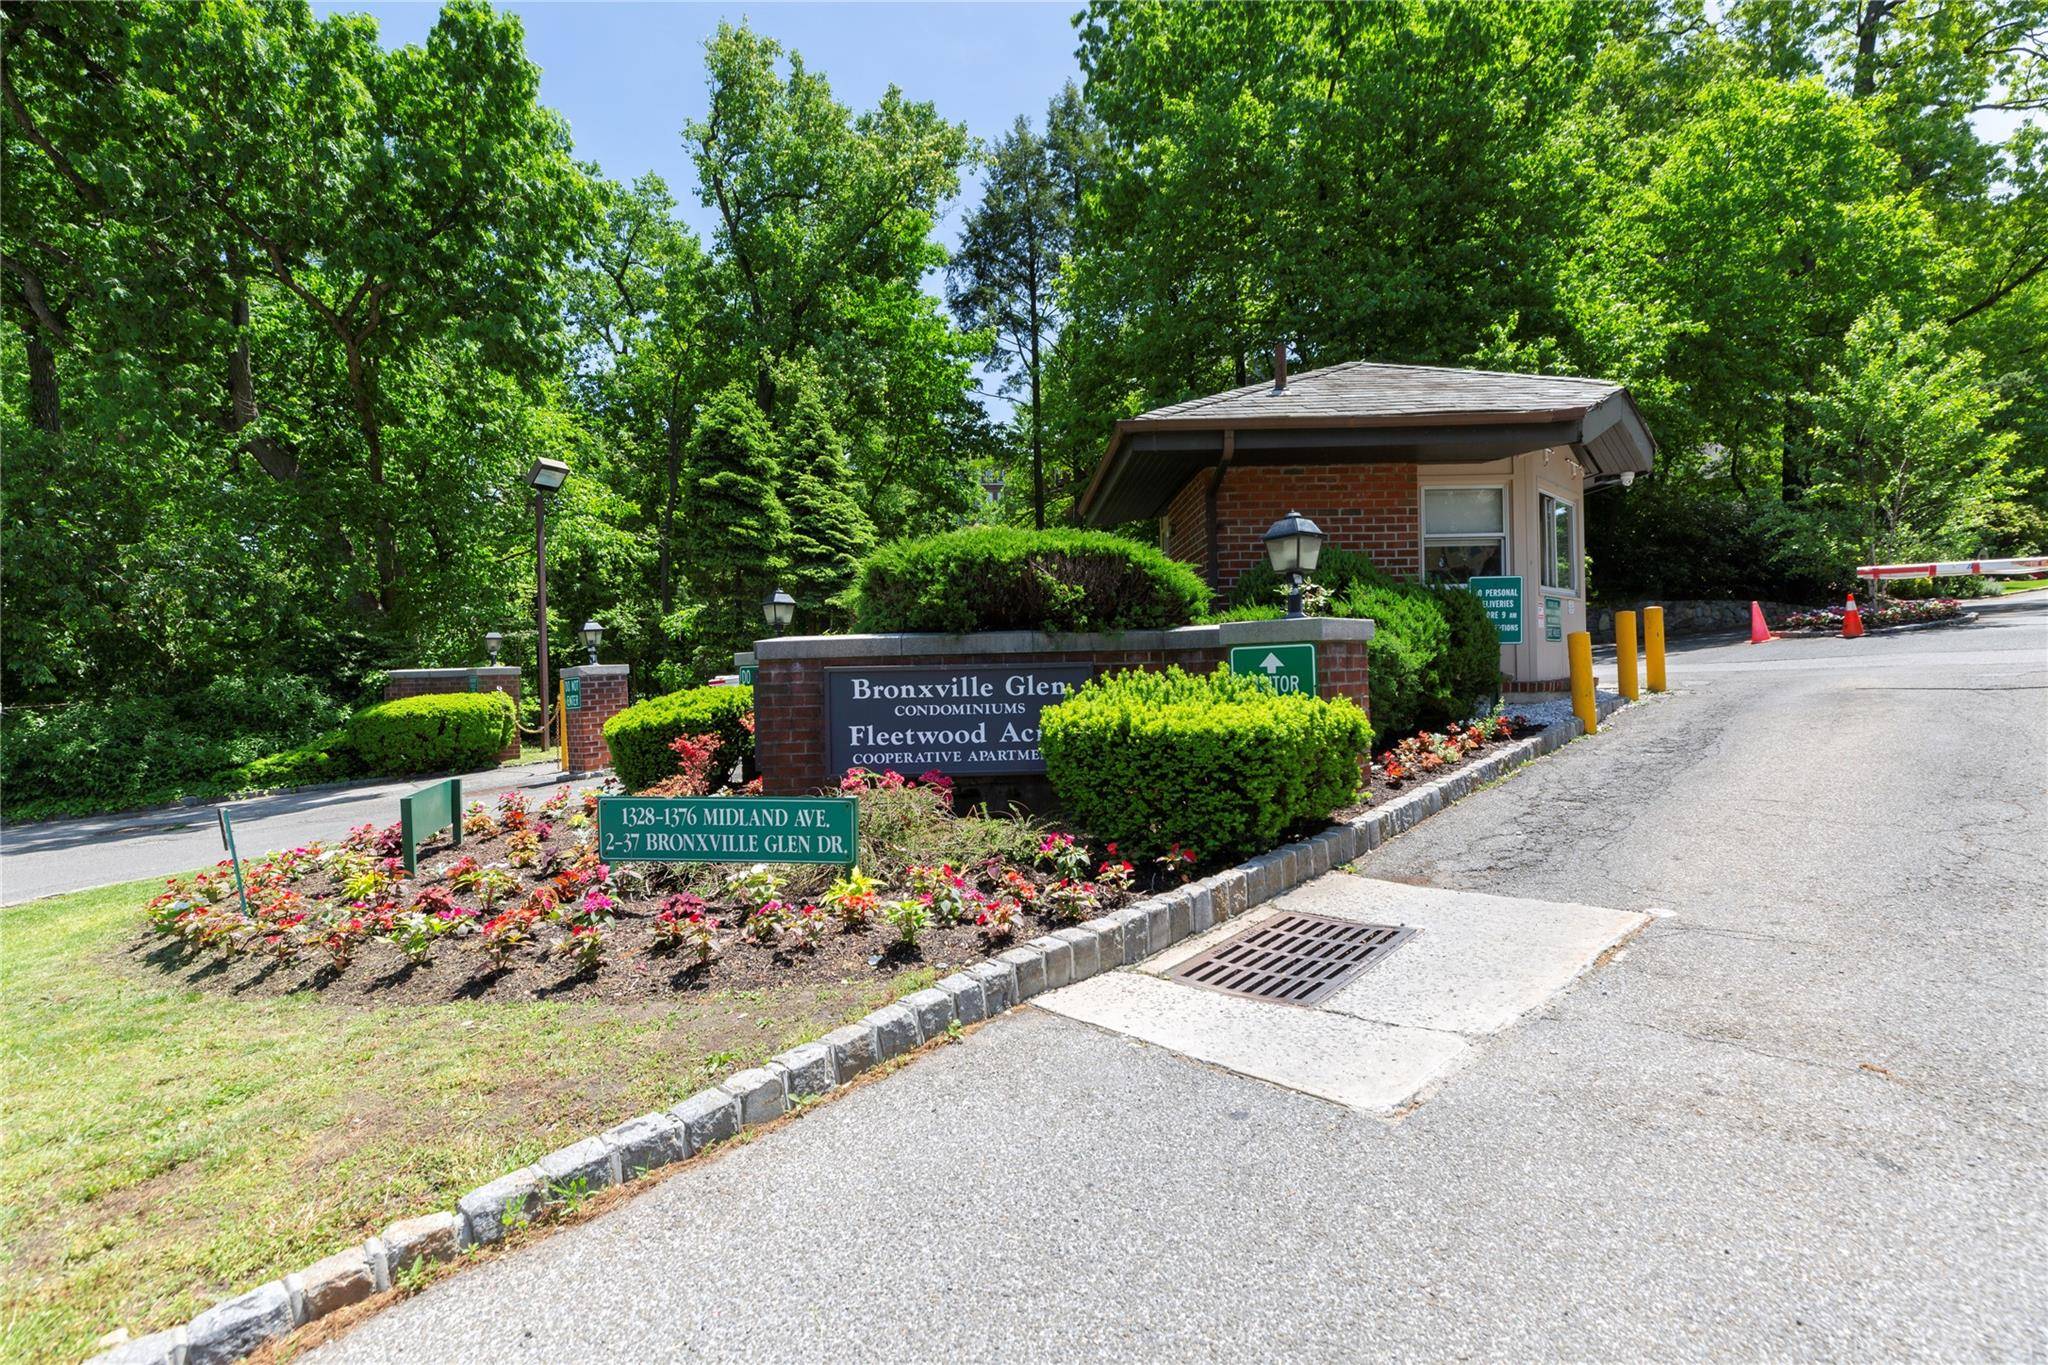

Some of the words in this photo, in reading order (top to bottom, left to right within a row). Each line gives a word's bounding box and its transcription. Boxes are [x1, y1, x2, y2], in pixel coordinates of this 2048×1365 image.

[1485, 588, 1519, 597] PERSONAL
[1486, 611, 1499, 619] ORE
[1501, 611, 1507, 619] 9
[1498, 624, 1519, 632] TIONS
[851, 676, 994, 700] Bronxville
[1005, 674, 1066, 697] Glen
[894, 703, 1026, 717] CONDOMINIUMS
[848, 721, 987, 746] Fleetwood
[999, 721, 1042, 744] Acr
[852, 750, 962, 765] COOPERATIVE
[622, 805, 698, 828] 1328-1376
[703, 807, 788, 827] MIDLAND
[794, 809, 830, 828] AVE.
[605, 832, 640, 853] 2-37
[646, 833, 759, 852] BRONXVILLE
[764, 835, 811, 853] GLEN
[817, 835, 849, 854] DR.
